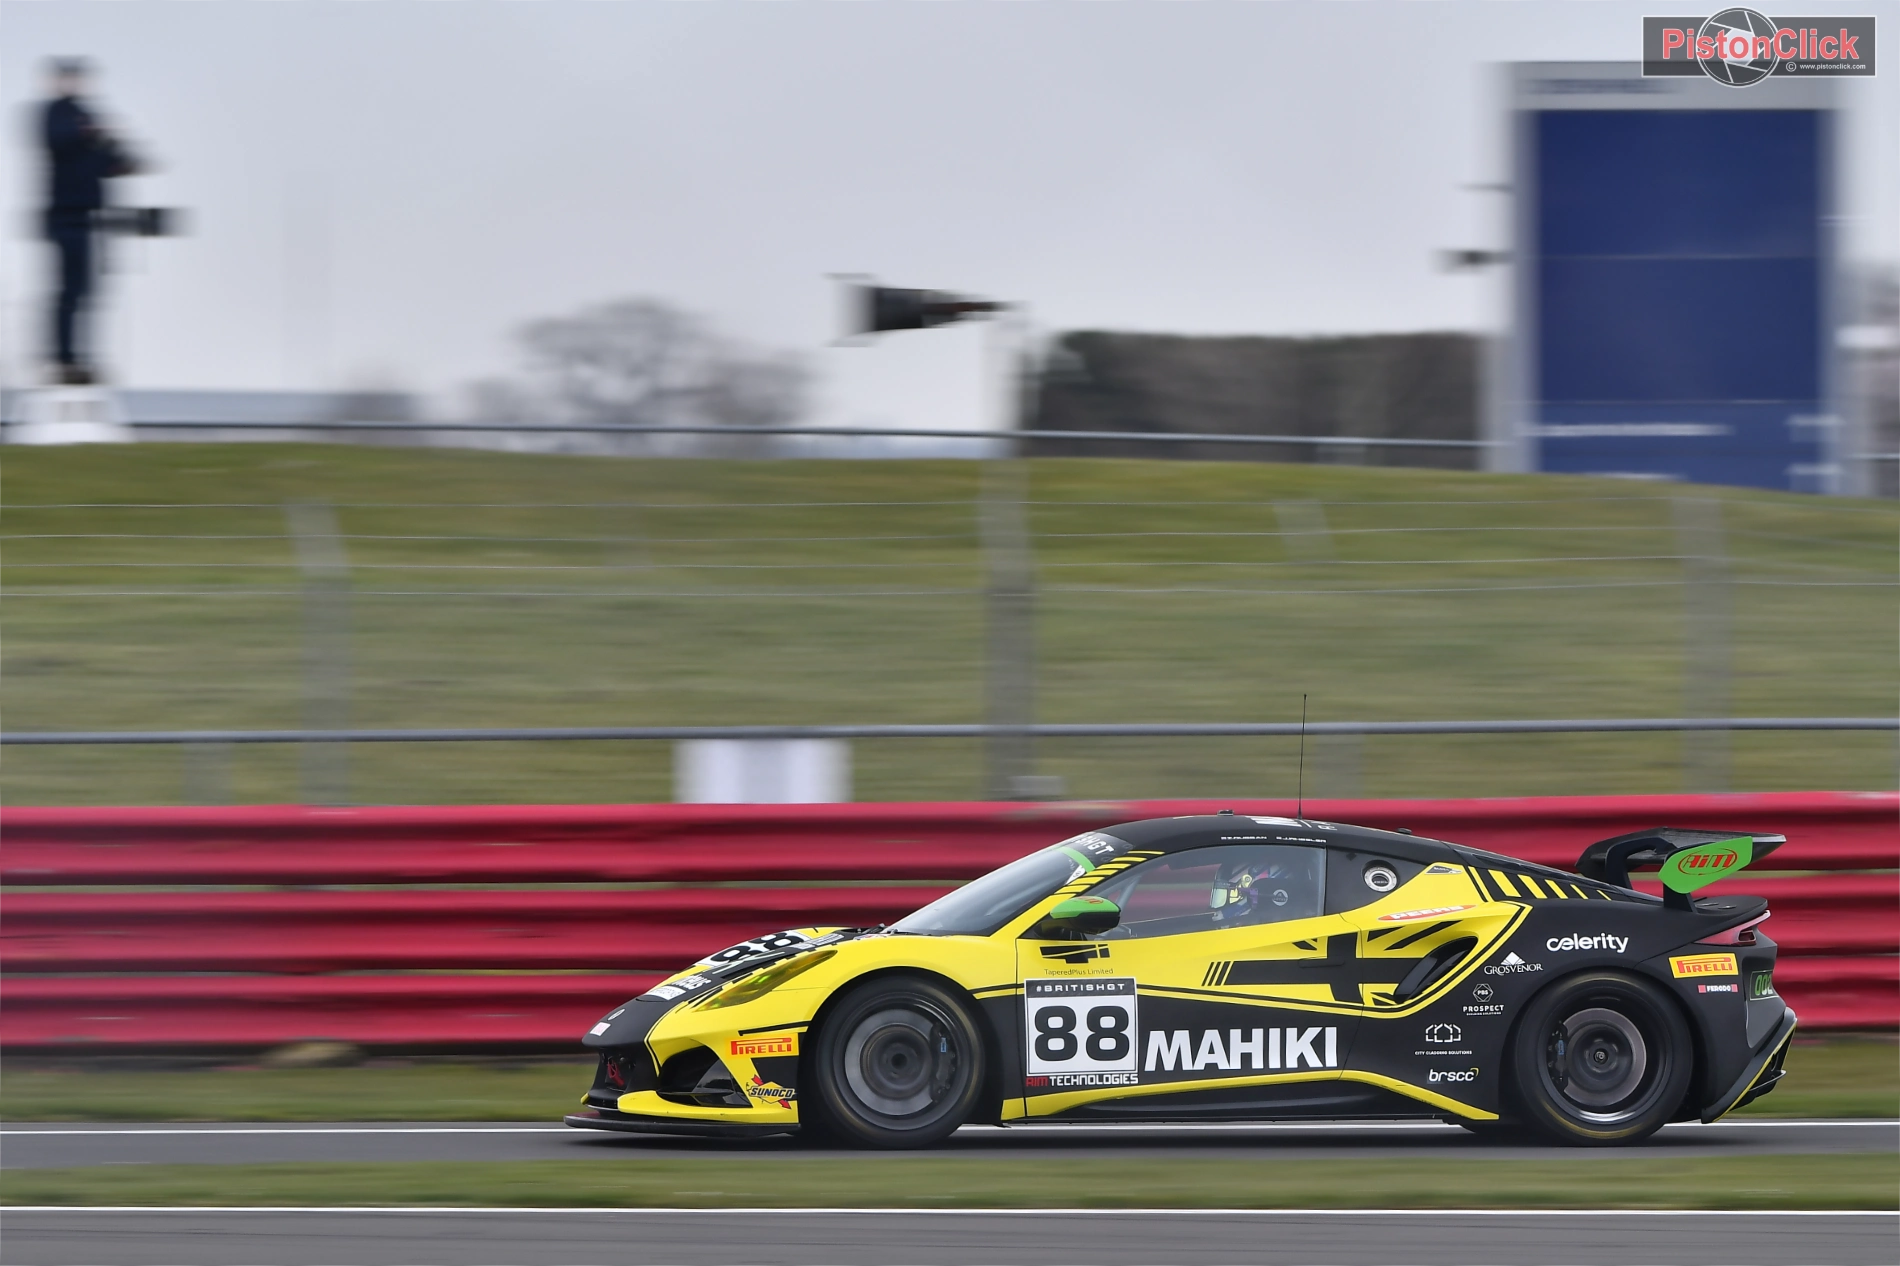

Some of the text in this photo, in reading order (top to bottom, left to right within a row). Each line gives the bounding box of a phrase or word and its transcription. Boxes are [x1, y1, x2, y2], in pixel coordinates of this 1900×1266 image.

[1546, 932, 1629, 953] celerity
[1044, 968, 1086, 976] TaperedPlus
[1483, 963, 1544, 976] GROSVENOR
[1676, 957, 1733, 974] PIRELLI
[1036, 983, 1125, 993] #BRITISHGT
[1706, 984, 1731, 993] FERODO
[1462, 1004, 1505, 1013] PROSPECT
[1034, 1005, 1130, 1062] 88
[730, 1037, 792, 1056] PIRELLI
[1144, 1026, 1338, 1072] MAHIKI
[1049, 1073, 1139, 1087] TECHNOLOGIES
[1428, 1068, 1475, 1082] brscc
[750, 1087, 795, 1098] SUNOCO
